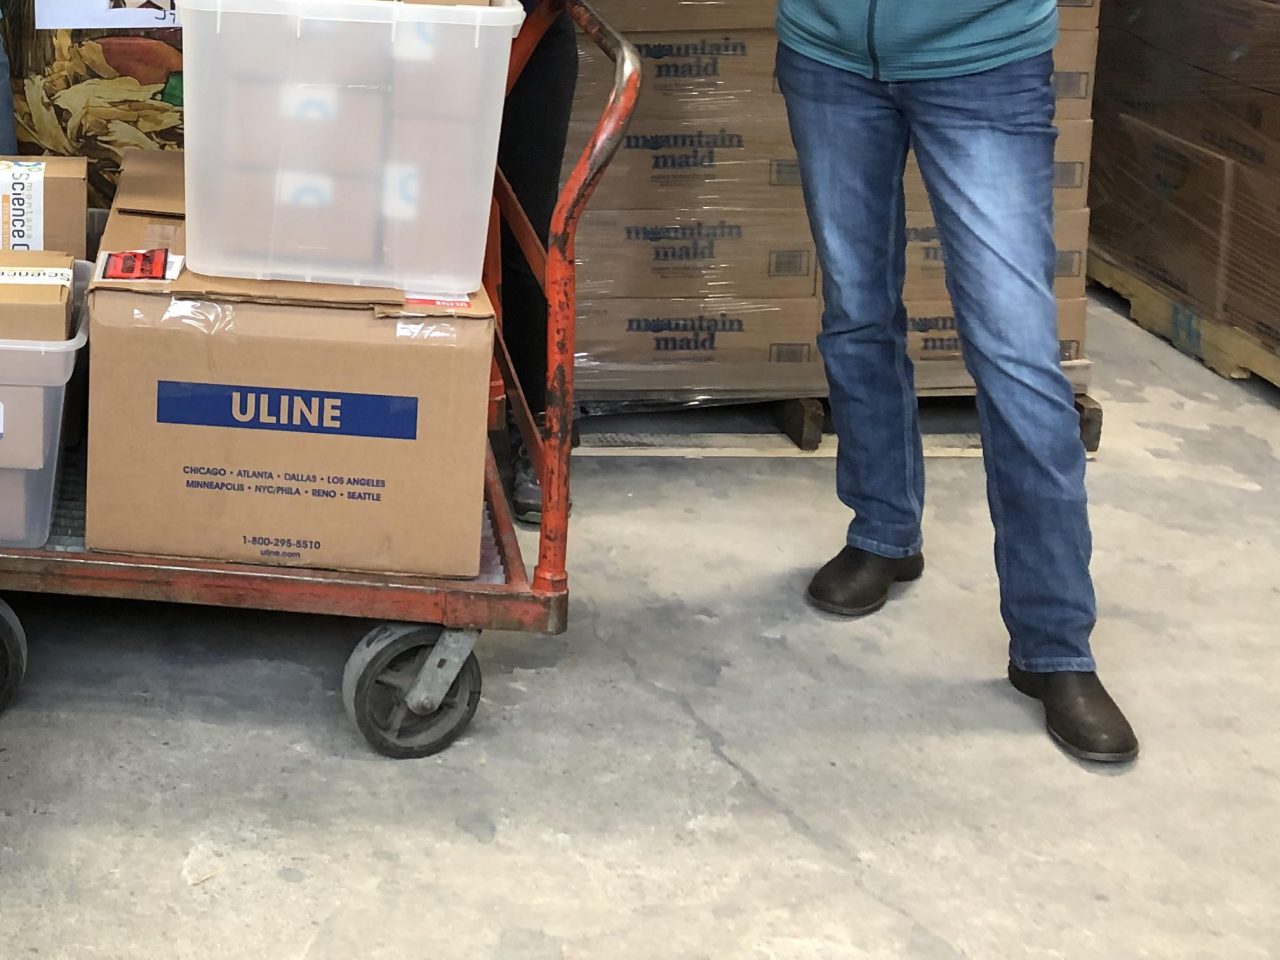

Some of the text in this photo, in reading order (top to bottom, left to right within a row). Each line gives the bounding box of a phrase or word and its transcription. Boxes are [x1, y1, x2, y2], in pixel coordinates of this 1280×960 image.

[655, 58, 718, 78] maid
[652, 149, 714, 170] maid
[12, 173, 29, 238] Science
[653, 241, 714, 261] maid
[654, 332, 714, 351] maid
[231, 392, 342, 428] ULINE
[183, 465, 385, 488] CHICAGO ATLANTA DALLAS LOS ANGELES
[186, 480, 381, 502] MINNEAPOLIS NYC/PHILA RENO SEATTLE
[242, 535, 320, 550] 1-800-295-5510
[260, 548, 300, 559] uline.com
